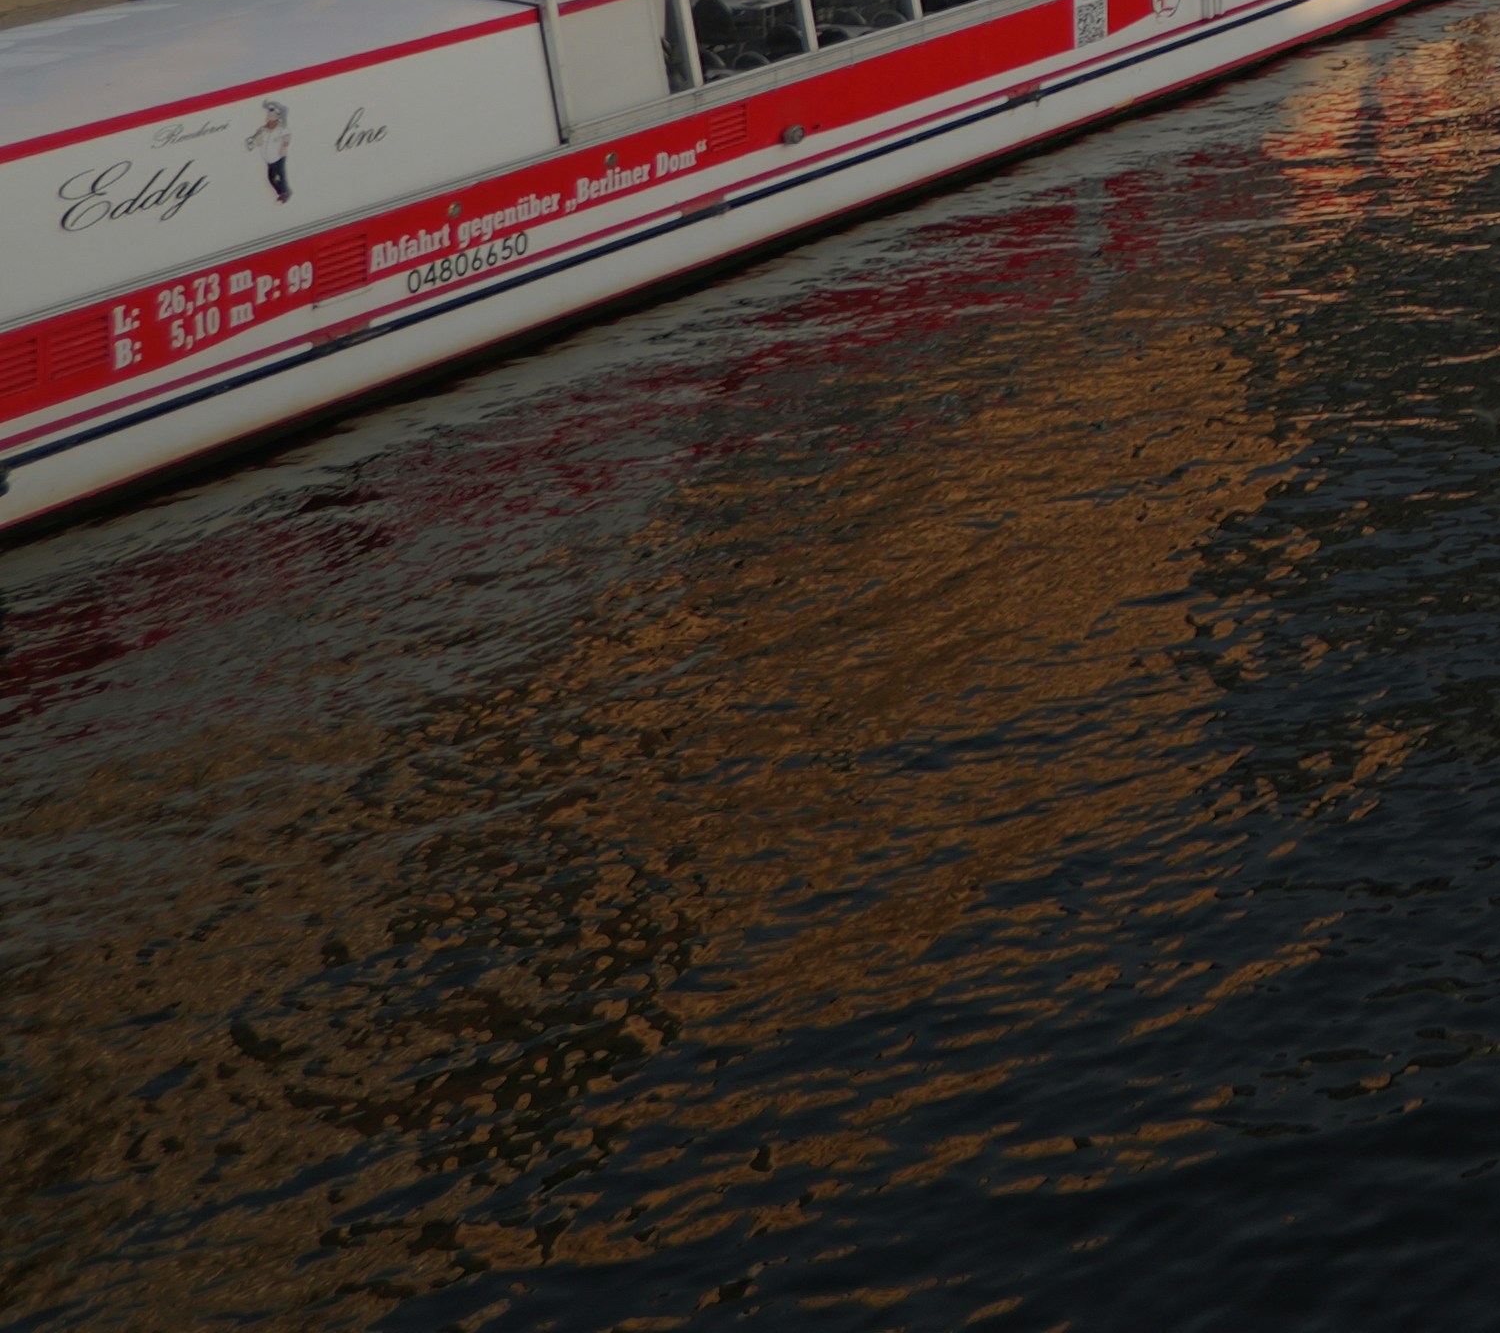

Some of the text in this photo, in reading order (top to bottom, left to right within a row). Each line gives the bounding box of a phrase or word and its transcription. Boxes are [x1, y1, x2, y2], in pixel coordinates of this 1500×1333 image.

[59, 108, 387, 231] Eddy line
[370, 139, 709, 272] Abfahrt gegenüber „Berliner Dom“
[255, 261, 313, 305] P: 99
[405, 232, 529, 294] 04806650
[113, 269, 253, 336] L: 26,73 m
[114, 301, 255, 370] B: 5,10 m
